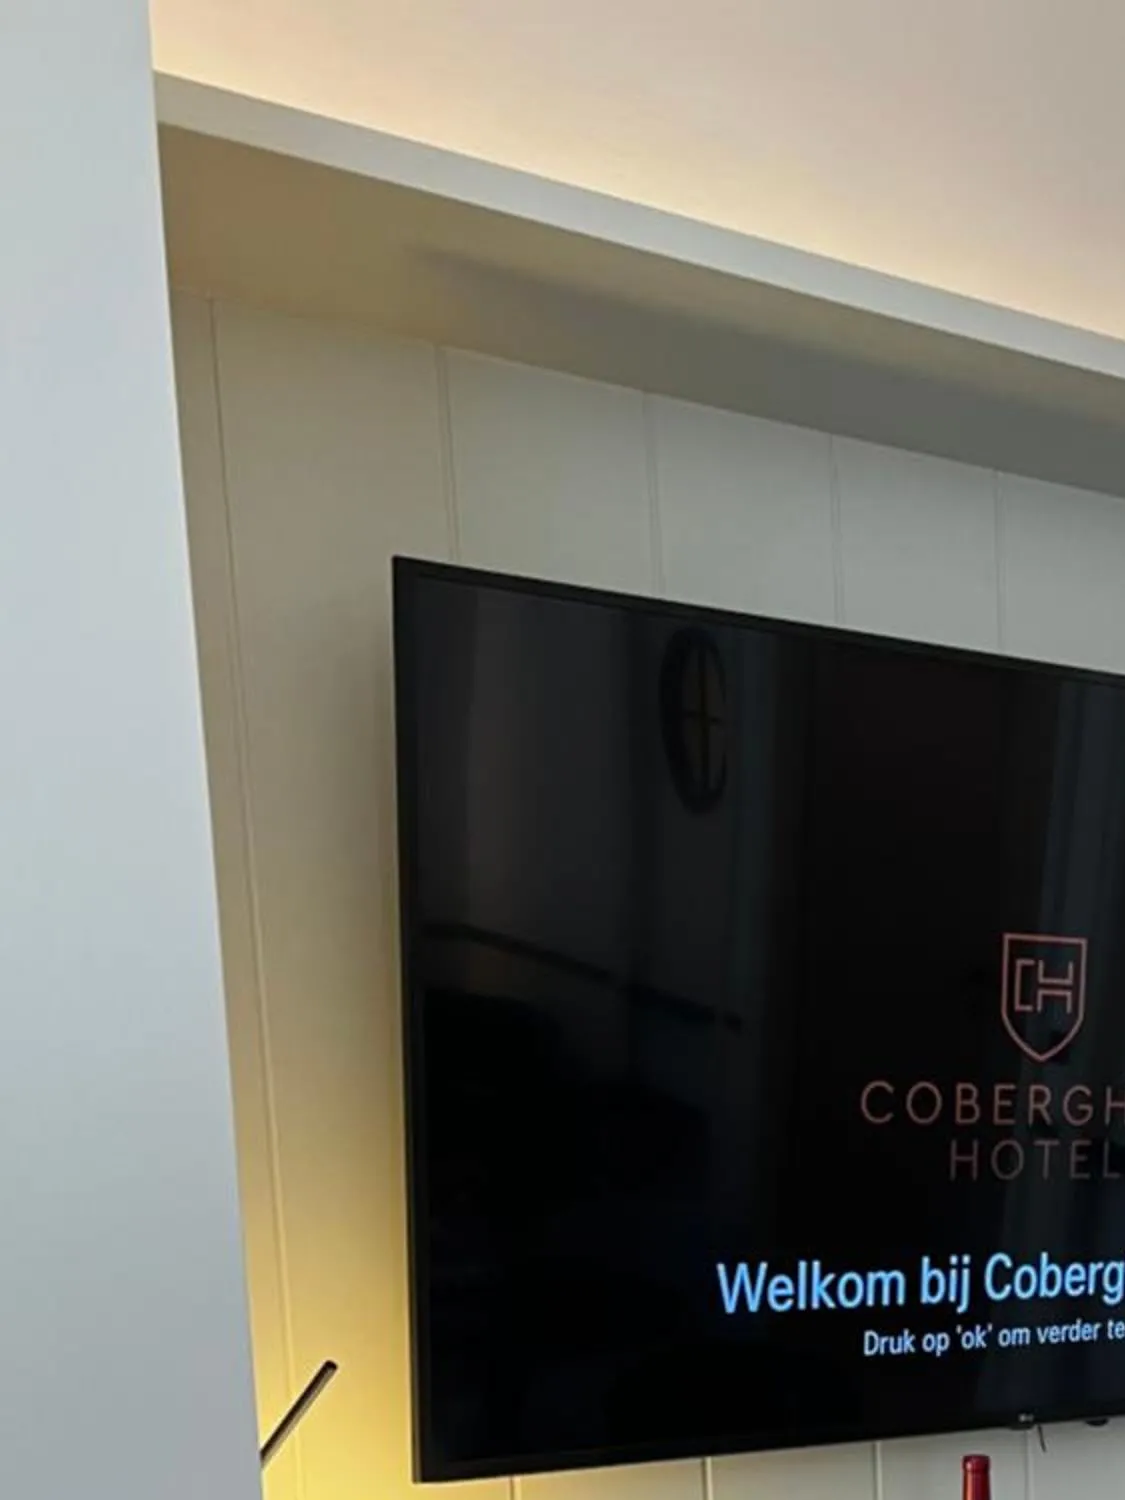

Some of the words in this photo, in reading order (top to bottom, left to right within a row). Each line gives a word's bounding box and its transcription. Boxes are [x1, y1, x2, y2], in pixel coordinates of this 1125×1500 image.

[949, 1139, 1120, 1180] HOTEL
[717, 1260, 905, 1314] Welkom
[920, 1254, 972, 1313] bij
[863, 1329, 916, 1356] Druk
[922, 1333, 950, 1356] op
[998, 1329, 1031, 1347] om
[1036, 1319, 1101, 1344] verder
[1107, 1321, 1125, 1341] te
